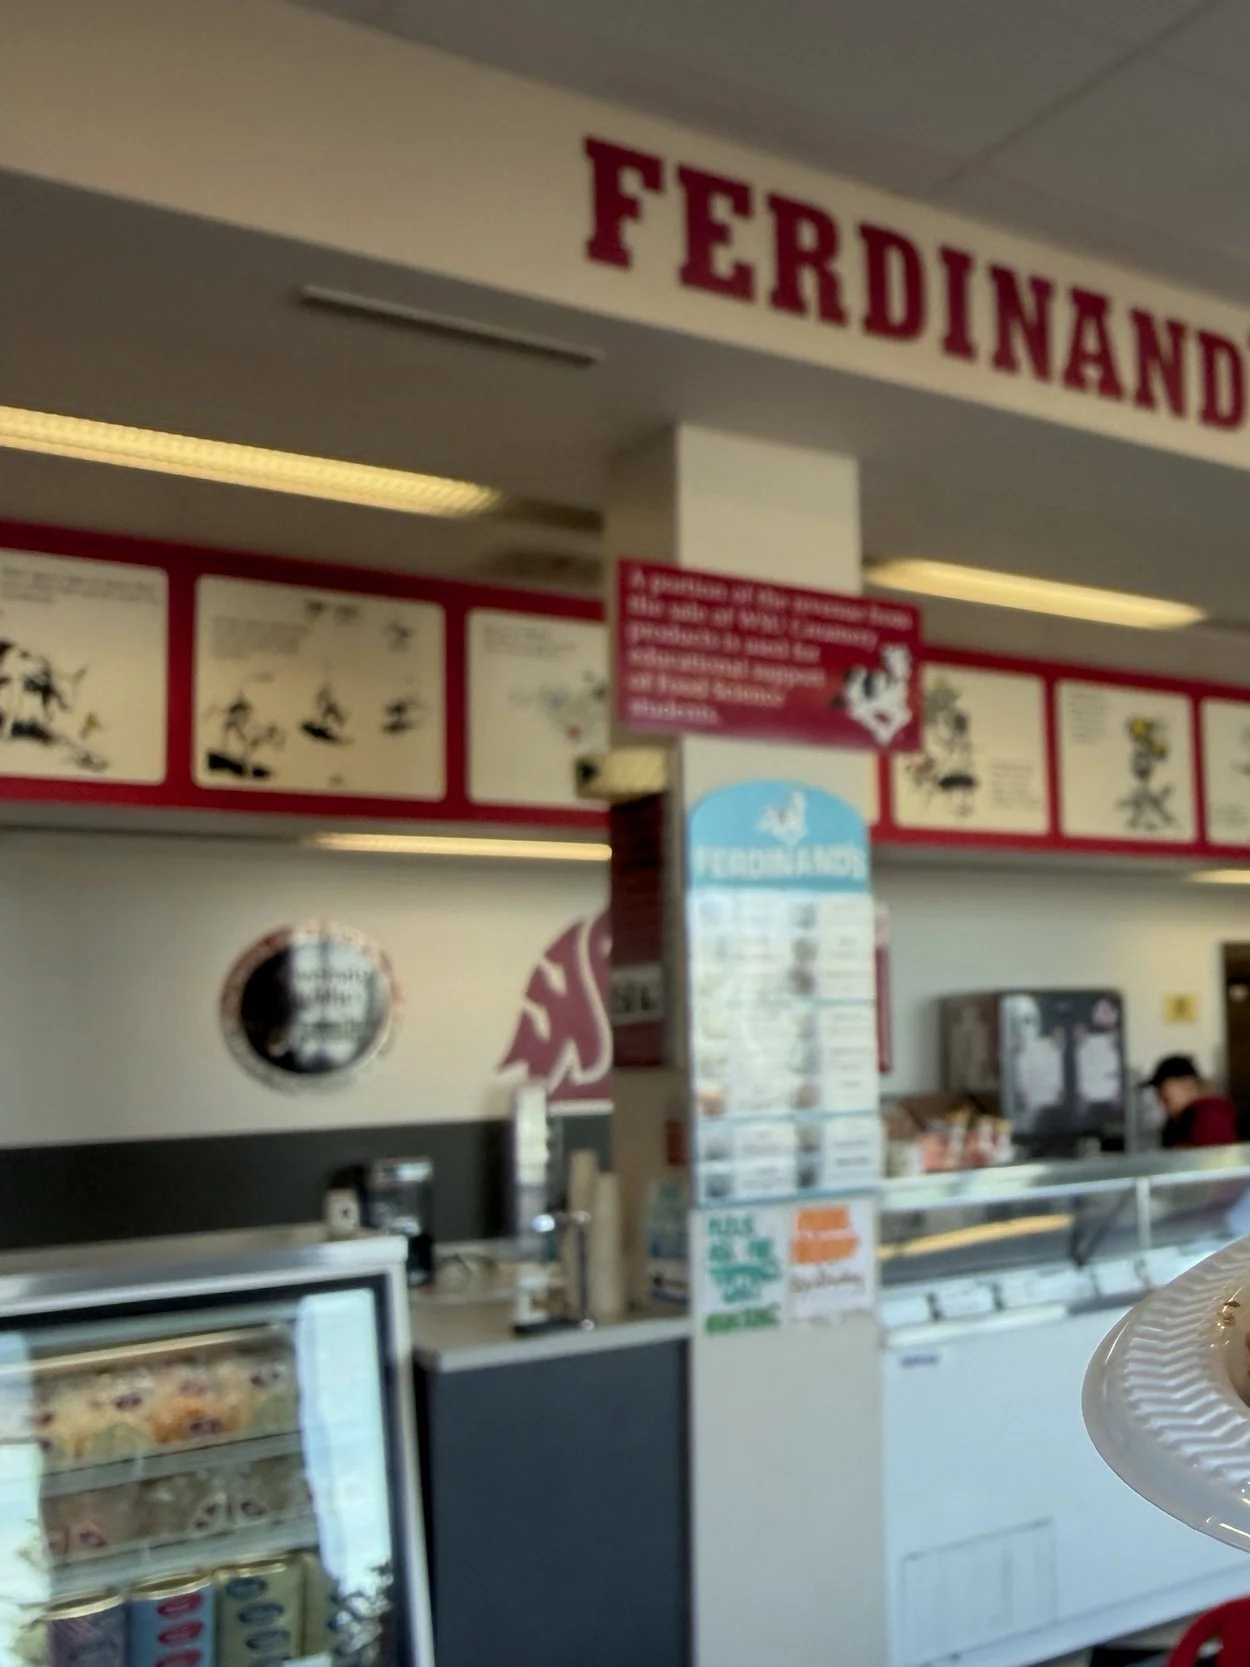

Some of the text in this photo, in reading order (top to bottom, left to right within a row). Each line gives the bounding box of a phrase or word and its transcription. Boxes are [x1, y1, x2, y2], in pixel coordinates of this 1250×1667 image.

[628, 565, 646, 588] A
[651, 573, 728, 601] portion
[731, 582, 754, 604] of
[757, 587, 788, 608] the
[627, 594, 662, 616] the
[710, 606, 734, 627] of
[627, 622, 721, 650] products
[627, 648, 750, 677] educational
[627, 672, 651, 692] of
